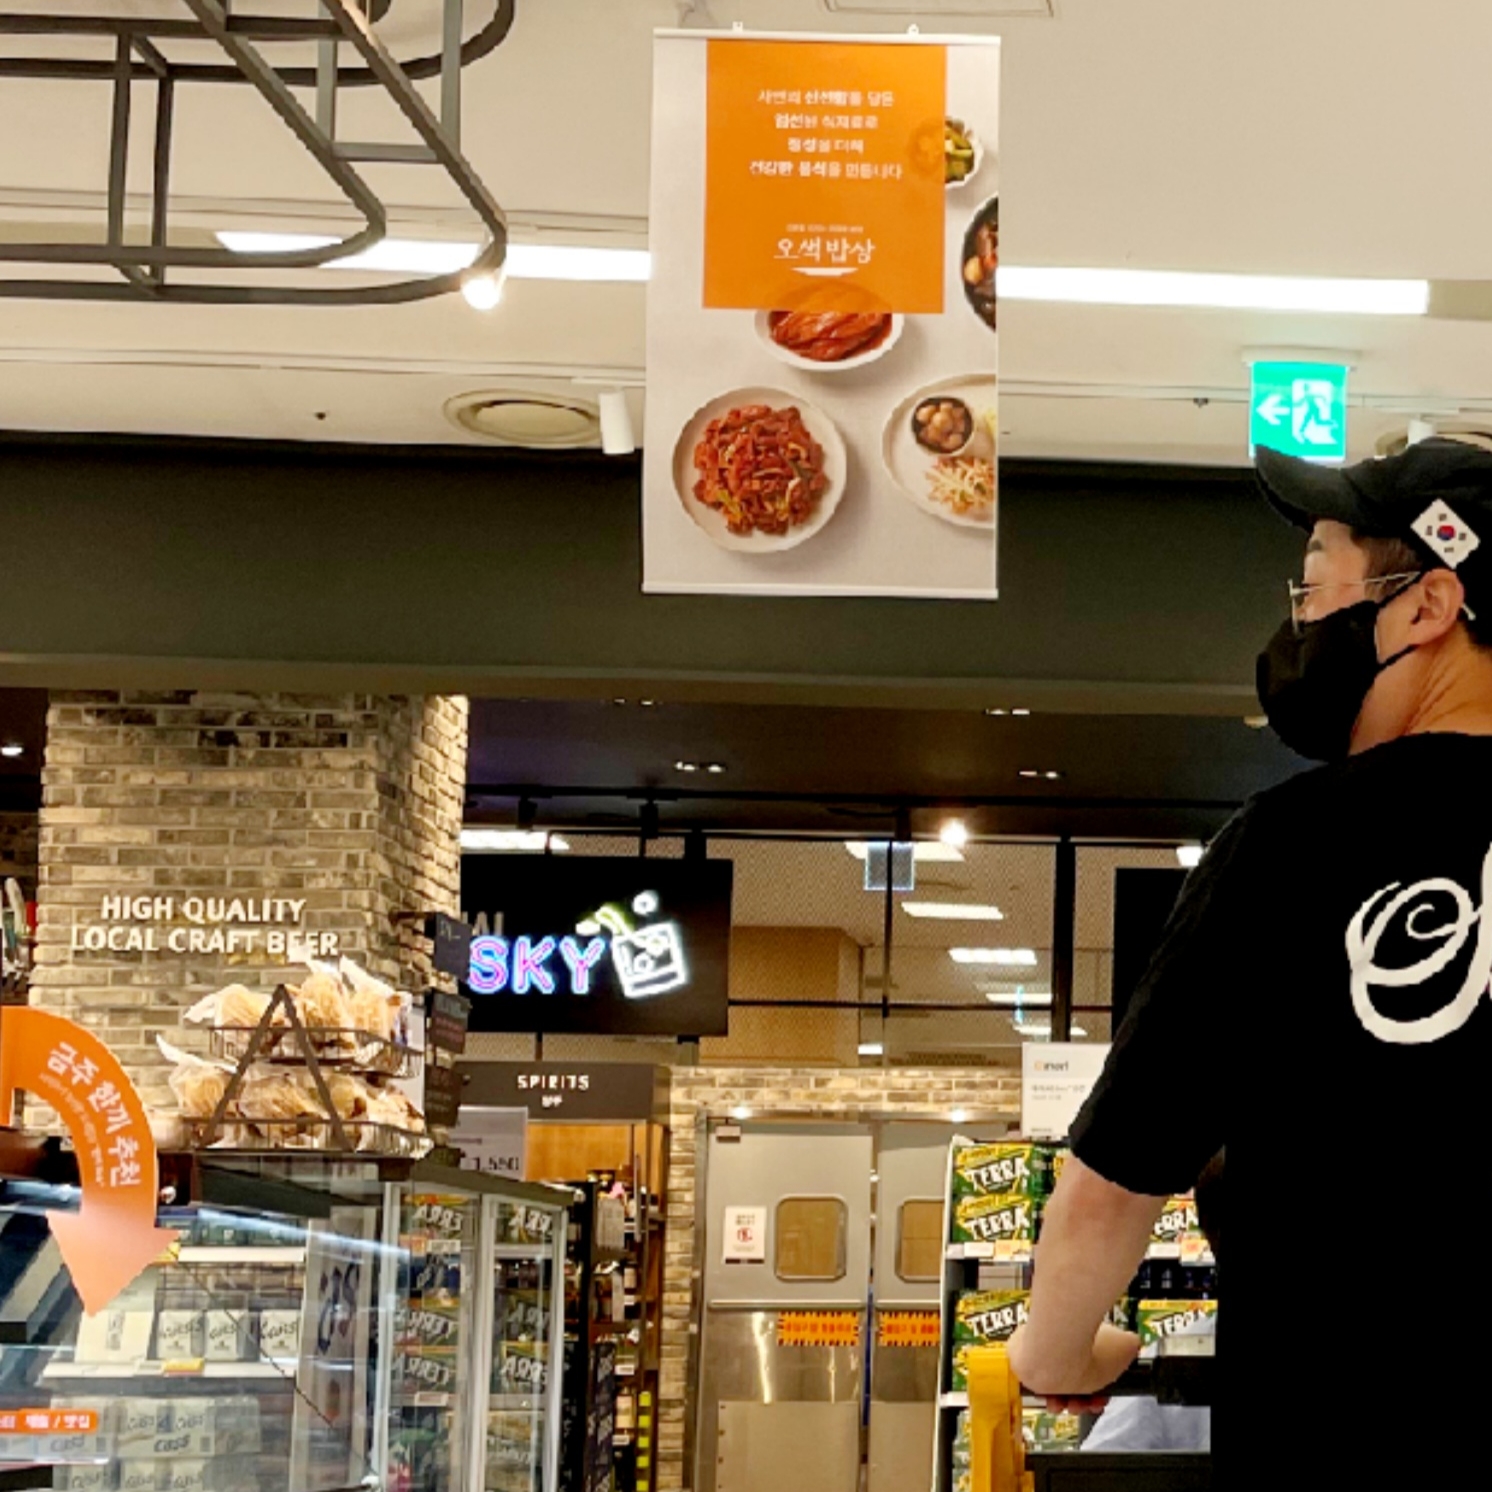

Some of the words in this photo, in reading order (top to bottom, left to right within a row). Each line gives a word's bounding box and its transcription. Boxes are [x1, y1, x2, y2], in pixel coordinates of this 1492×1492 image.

[100, 894, 173, 921] HIGH
[182, 897, 306, 925] QUALITY
[71, 924, 158, 951] LOCAL
[168, 927, 261, 954] CRAFT
[267, 930, 339, 956] BEER
[47, 1041, 100, 1086] 금주
[517, 1074, 590, 1090] SPIRITS
[86, 1080, 133, 1134] 한끼
[107, 1136, 142, 1188] 추천
[964, 1157, 1030, 1191] TERRA
[964, 1206, 1030, 1240] TERRA
